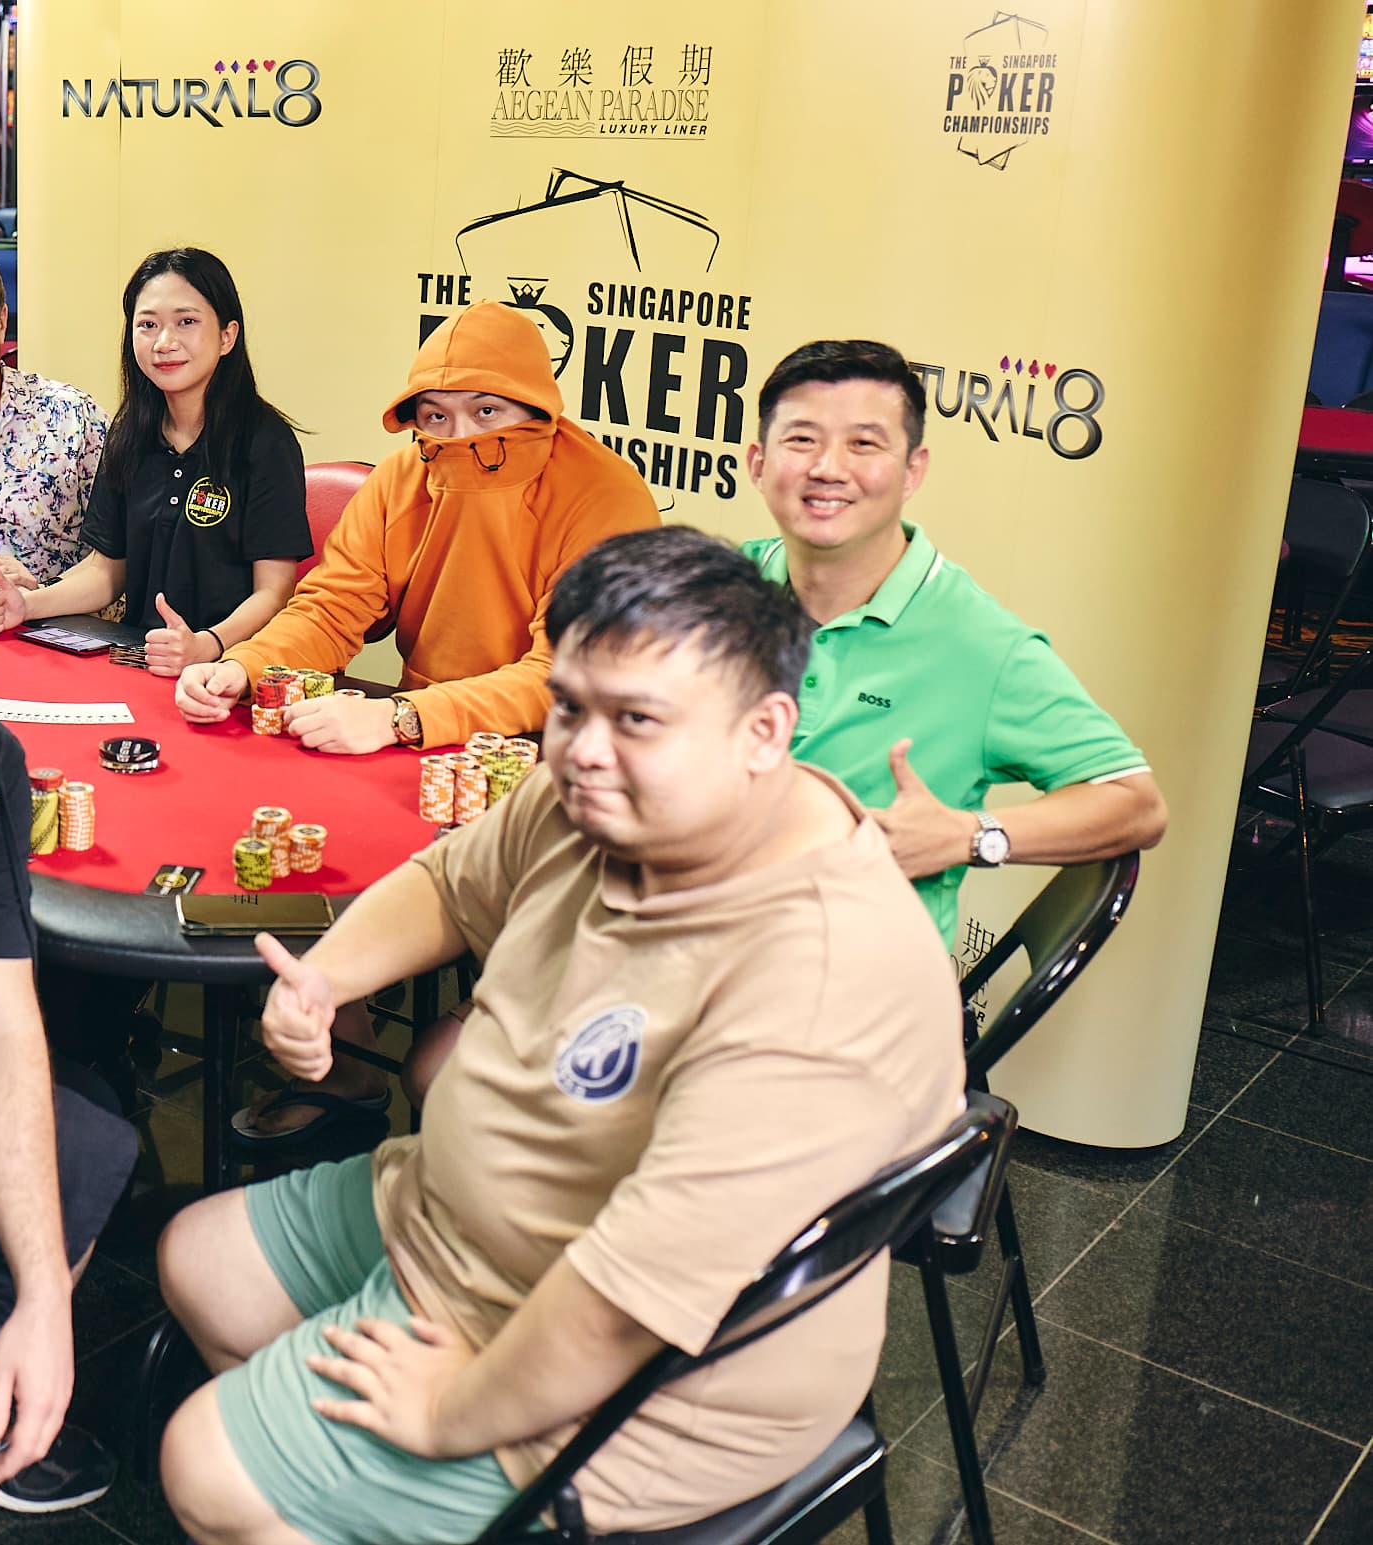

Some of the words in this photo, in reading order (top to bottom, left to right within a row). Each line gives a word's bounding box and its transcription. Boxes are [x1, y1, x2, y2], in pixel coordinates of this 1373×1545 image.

[495, 43, 713, 88] 歡樂假期
[949, 56, 968, 69] THE
[1002, 54, 1057, 69] SINGAPORE
[62, 59, 322, 128] NATURAL8
[491, 90, 593, 121] AEGEAN
[598, 89, 709, 122] PARADISE
[600, 124, 657, 135] LUXURY
[664, 125, 708, 135] LINER
[943, 115, 1050, 135] CHAMPIONSHIPS
[418, 273, 472, 306] THE
[587, 282, 752, 331] SINGAPORE
[908, 361, 1106, 460] TURAL8
[857, 692, 891, 708] BOSS
